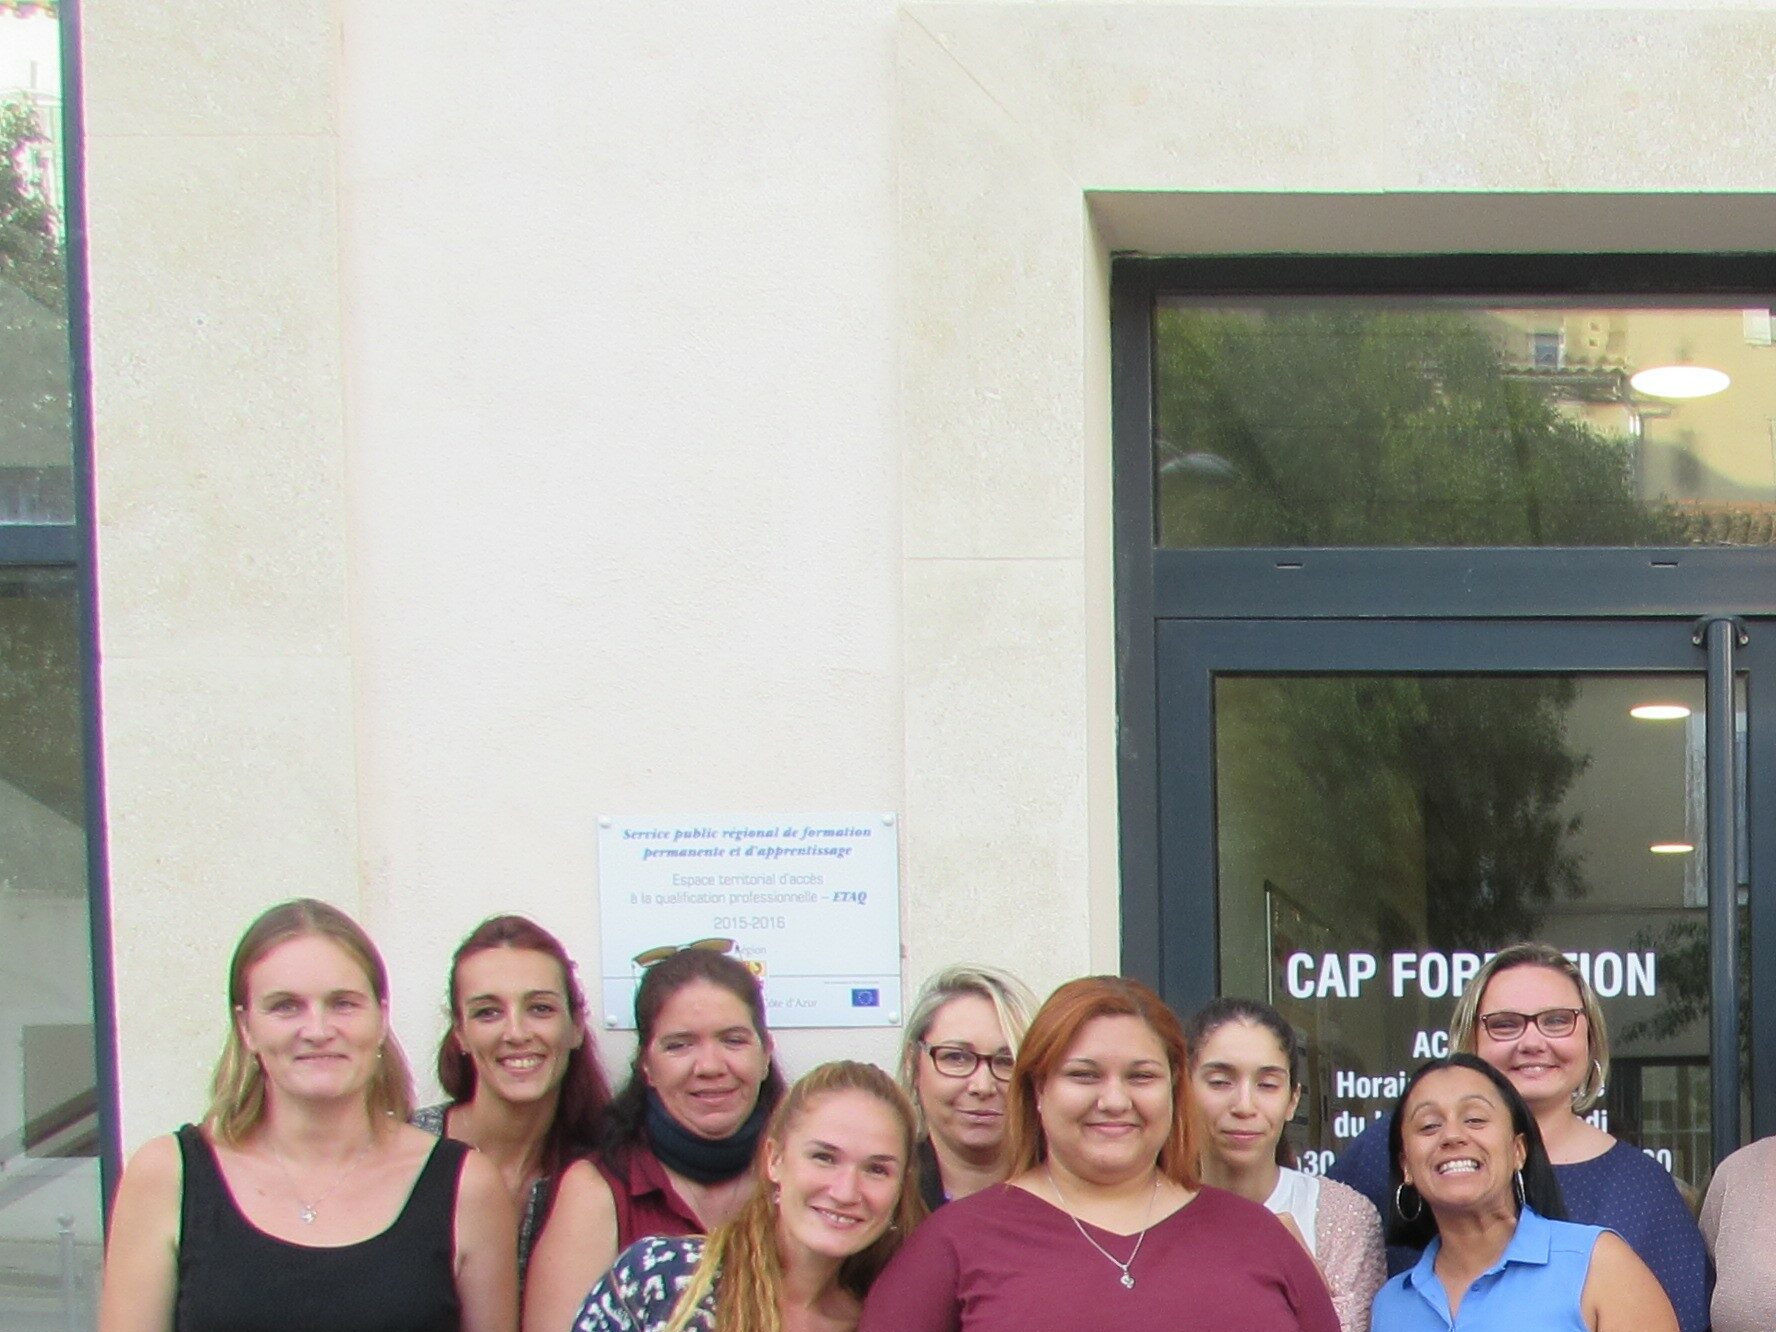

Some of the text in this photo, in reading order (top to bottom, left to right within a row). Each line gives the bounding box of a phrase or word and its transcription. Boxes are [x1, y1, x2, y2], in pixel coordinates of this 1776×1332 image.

[623, 826, 872, 842] Service public régional de formation
[643, 845, 853, 861] permanente et d'apprentissage
[672, 873, 824, 887] Espace territorial d'accès
[641, 892, 652, 904] la
[655, 892, 725, 906] qualification
[729, 891, 818, 906] professionnelle
[714, 916, 786, 930] 2015-2016
[1287, 951, 1656, 998] CAP FORION
[1334, 1110, 1365, 1138] du
